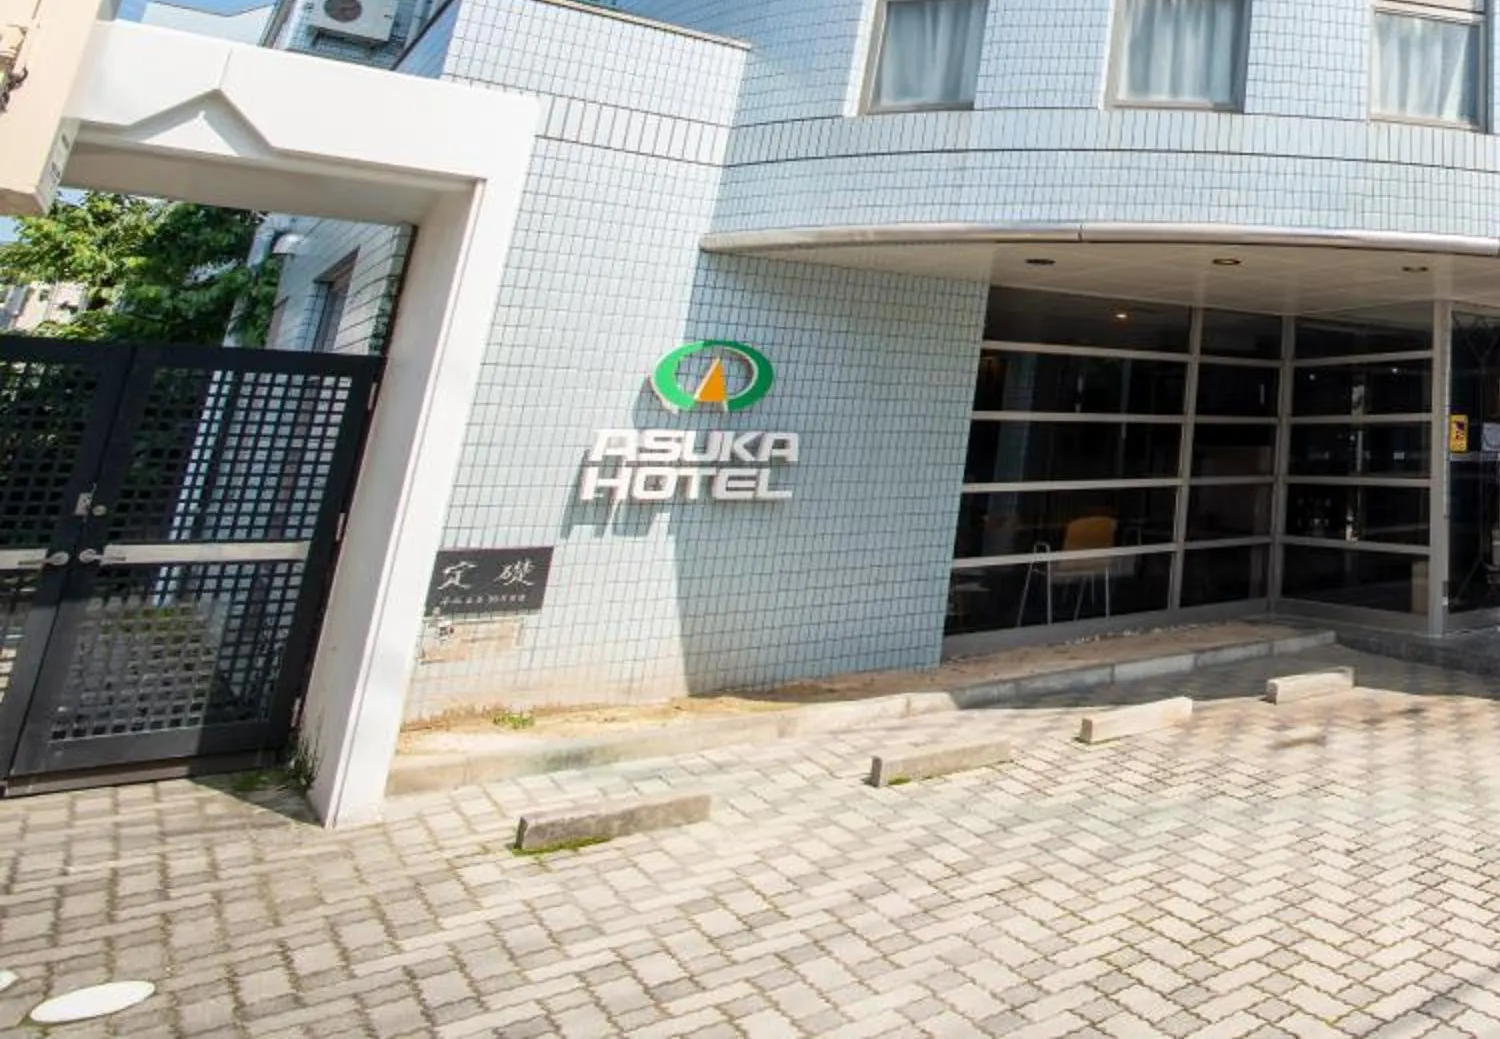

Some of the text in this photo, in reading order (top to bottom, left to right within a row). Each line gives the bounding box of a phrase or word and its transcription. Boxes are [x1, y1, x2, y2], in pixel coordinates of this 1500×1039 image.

[587, 428, 799, 462] ASUKA
[579, 466, 793, 501] HOTEL
[437, 558, 536, 590] 定礎
